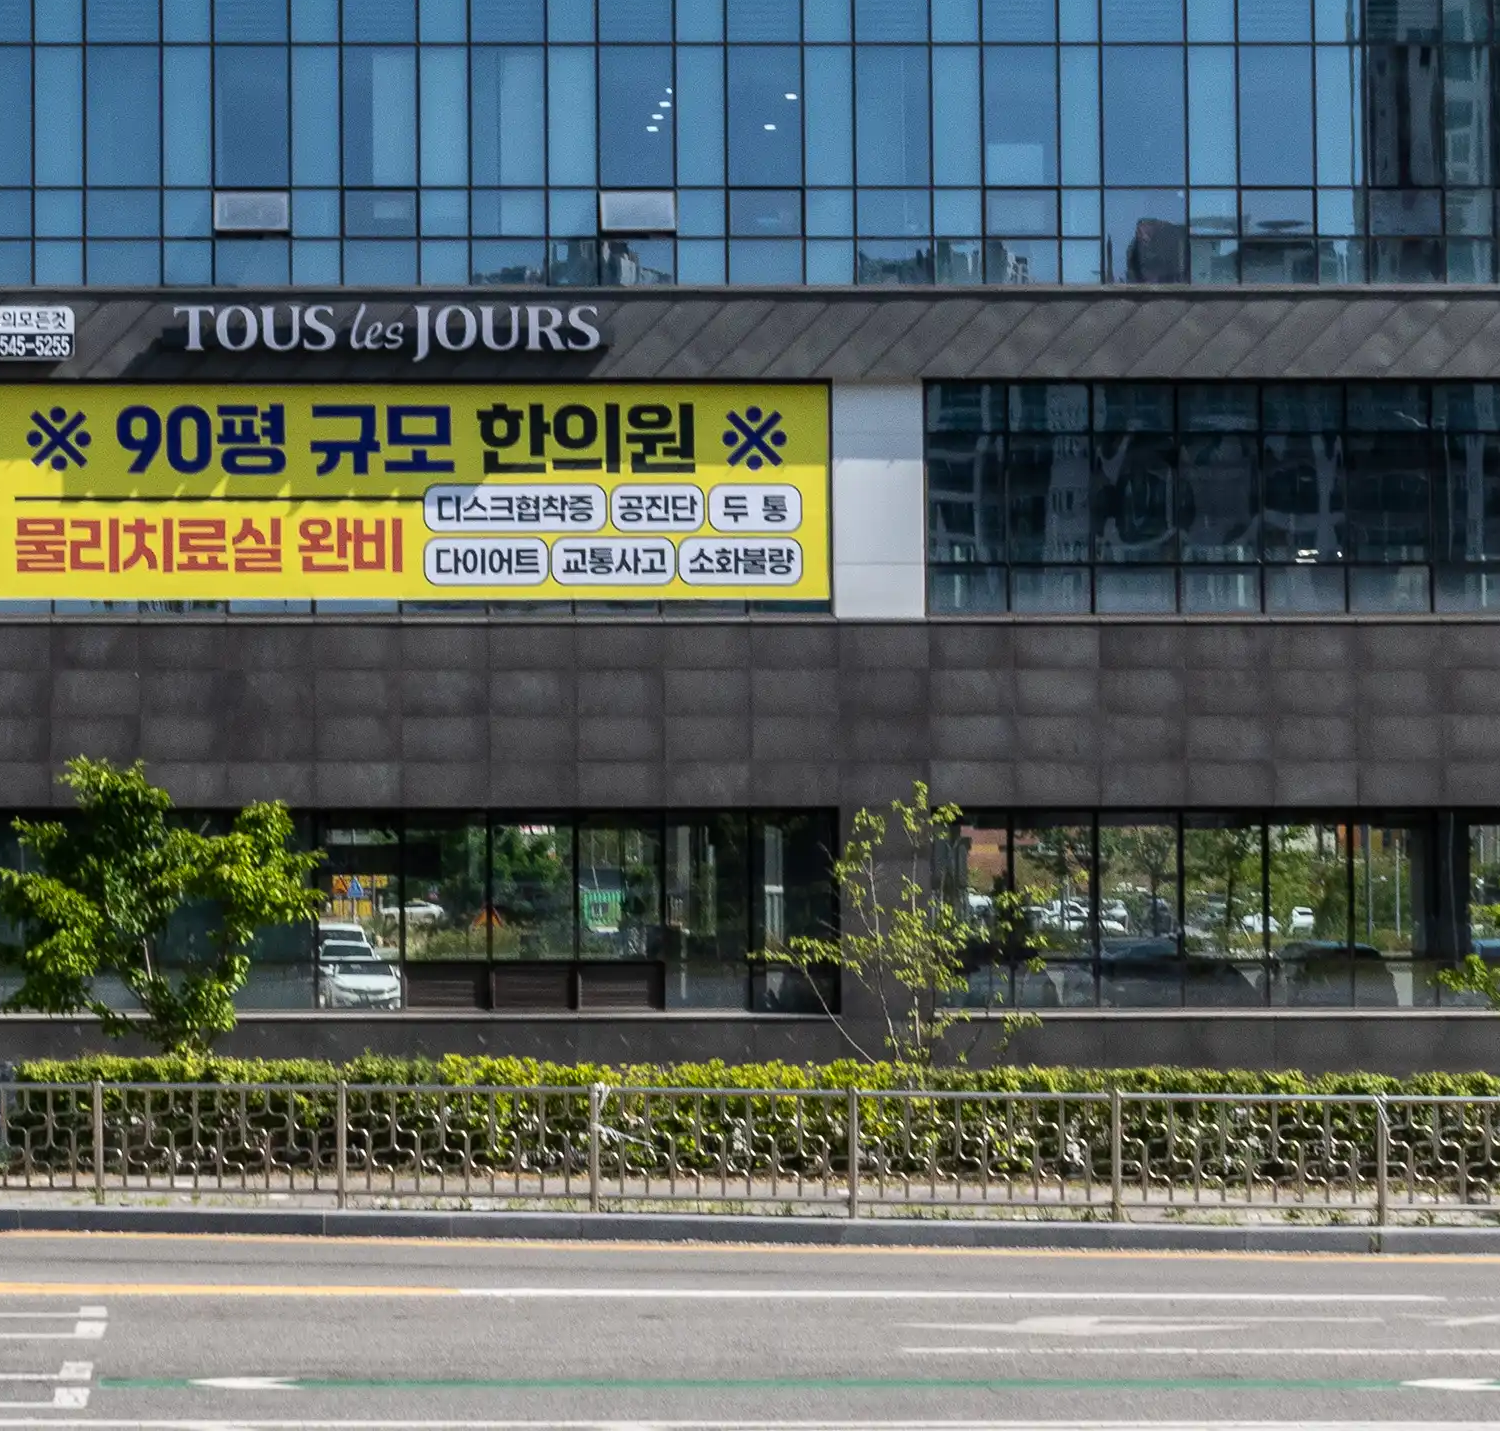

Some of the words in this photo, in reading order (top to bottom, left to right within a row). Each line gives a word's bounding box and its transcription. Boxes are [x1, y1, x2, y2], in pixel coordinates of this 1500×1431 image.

[0, 335, 71, 357] 545-5255
[173, 304, 337, 351] TOUS
[349, 303, 404, 350] les
[412, 304, 601, 362] JOURS
[116, 404, 286, 475] 90평
[310, 404, 455, 476] 규모
[477, 402, 696, 474] 한의원
[436, 495, 594, 522] 디스크협착증
[618, 495, 698, 522] 공진단
[14, 517, 283, 573] 물리치료실
[298, 517, 403, 573] 완비
[435, 547, 541, 576] 다이어트
[563, 547, 667, 576] 교통사고
[689, 547, 796, 576] 소화불량
